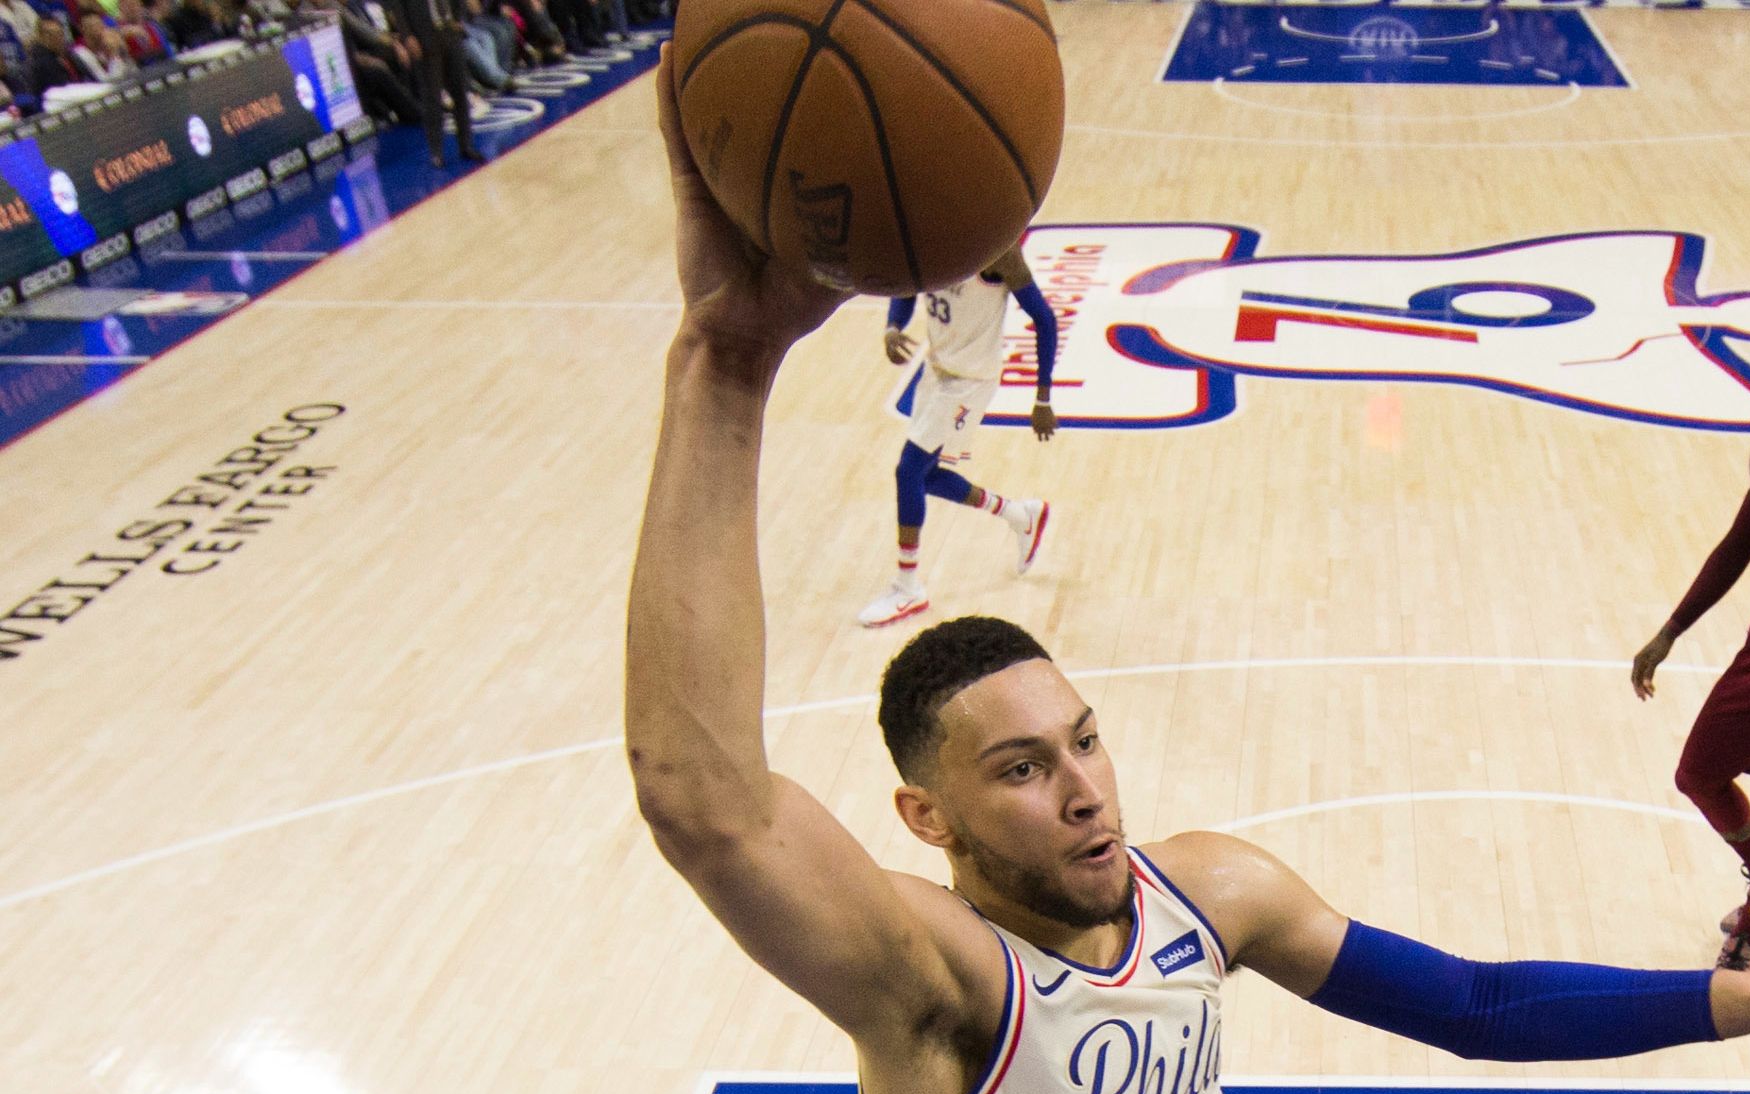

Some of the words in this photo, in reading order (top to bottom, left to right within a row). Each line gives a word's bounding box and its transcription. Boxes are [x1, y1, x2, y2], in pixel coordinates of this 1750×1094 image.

[156, 403, 346, 509] FARGO
[160, 465, 338, 575] CENTER
[1157, 944, 1196, 969] StubHub
